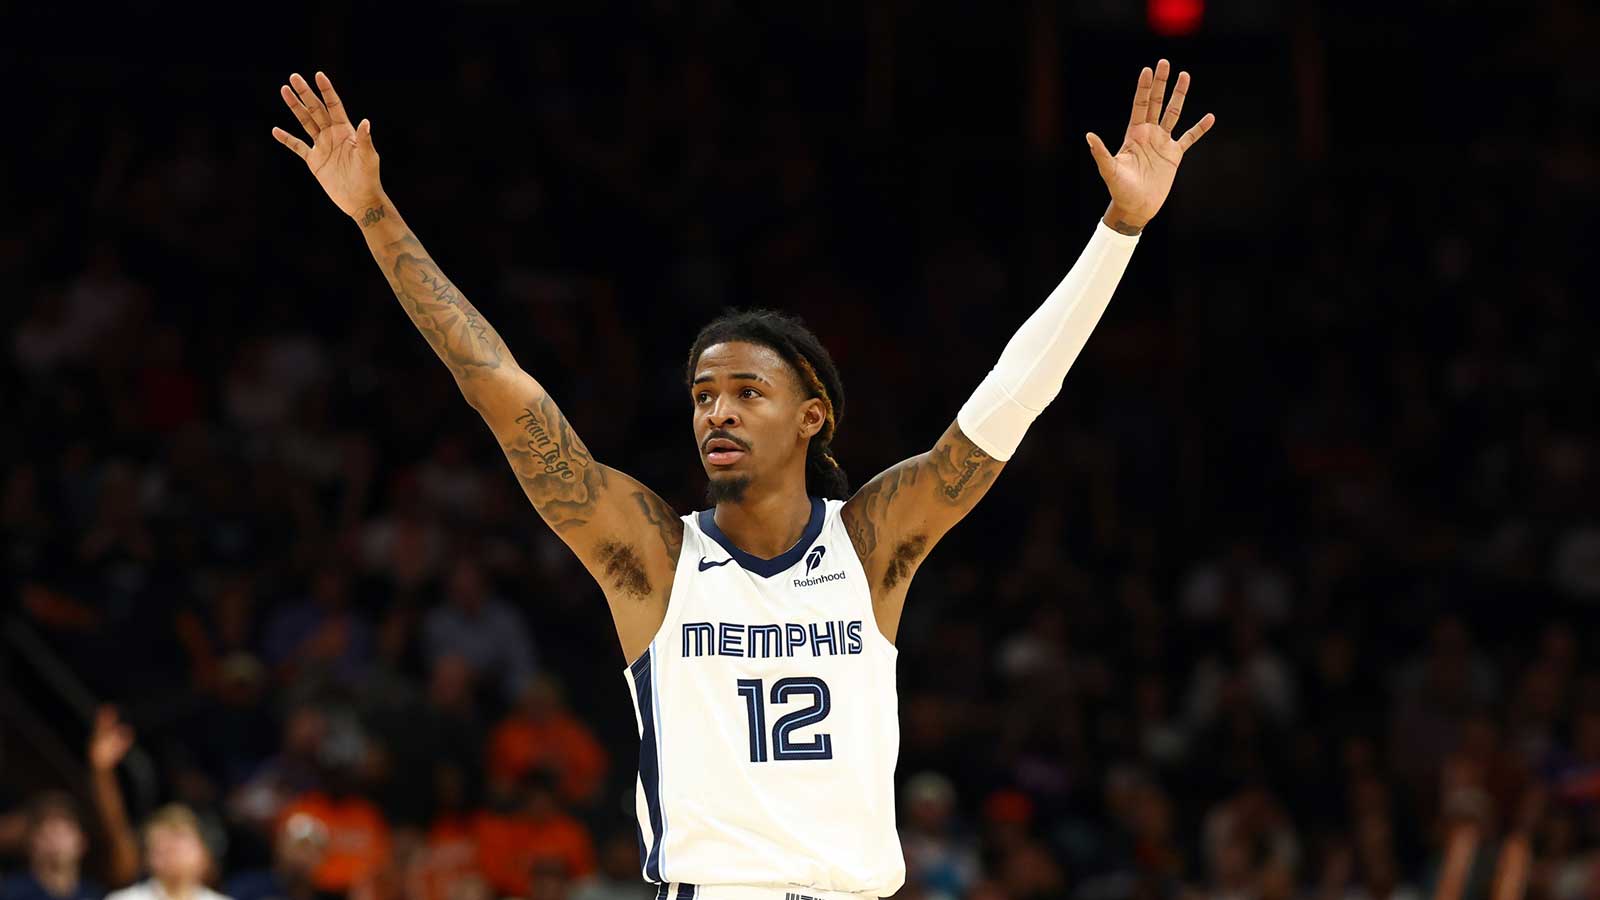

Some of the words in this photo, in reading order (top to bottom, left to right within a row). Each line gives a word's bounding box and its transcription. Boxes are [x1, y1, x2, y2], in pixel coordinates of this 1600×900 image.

[514, 408, 551, 449] Train
[793, 570, 846, 588] Robinhood
[681, 620, 863, 658] MEMPHIS
[736, 676, 833, 763] 12
